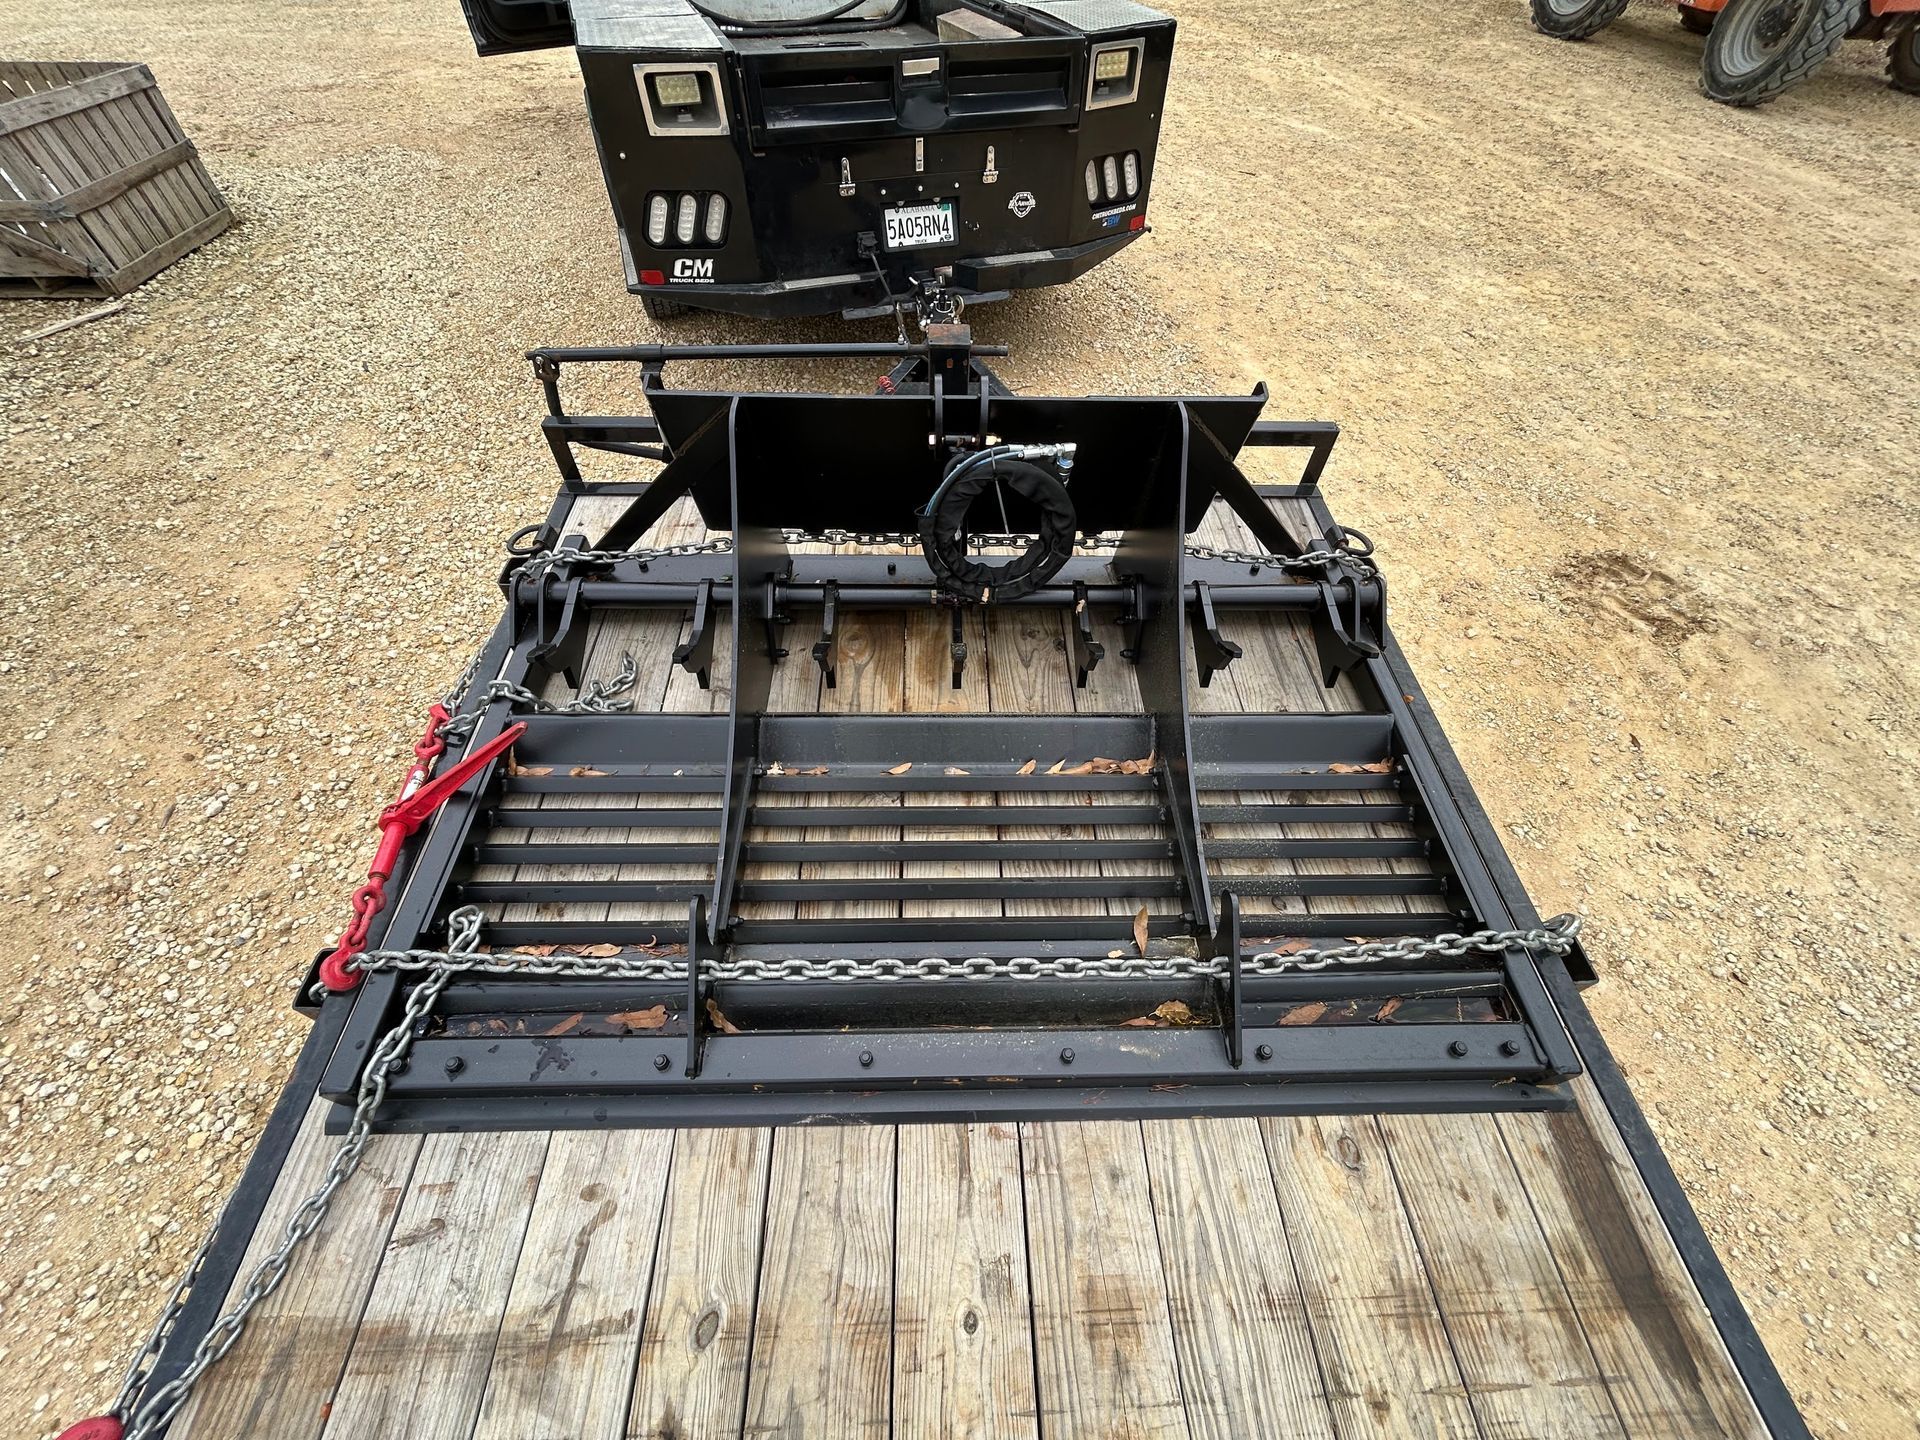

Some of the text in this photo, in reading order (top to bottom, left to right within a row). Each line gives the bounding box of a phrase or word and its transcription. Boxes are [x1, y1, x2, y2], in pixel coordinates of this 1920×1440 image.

[901, 206, 936, 214] ALABAMA
[887, 213, 950, 240] 5A05RN4
[673, 258, 714, 277] CM
